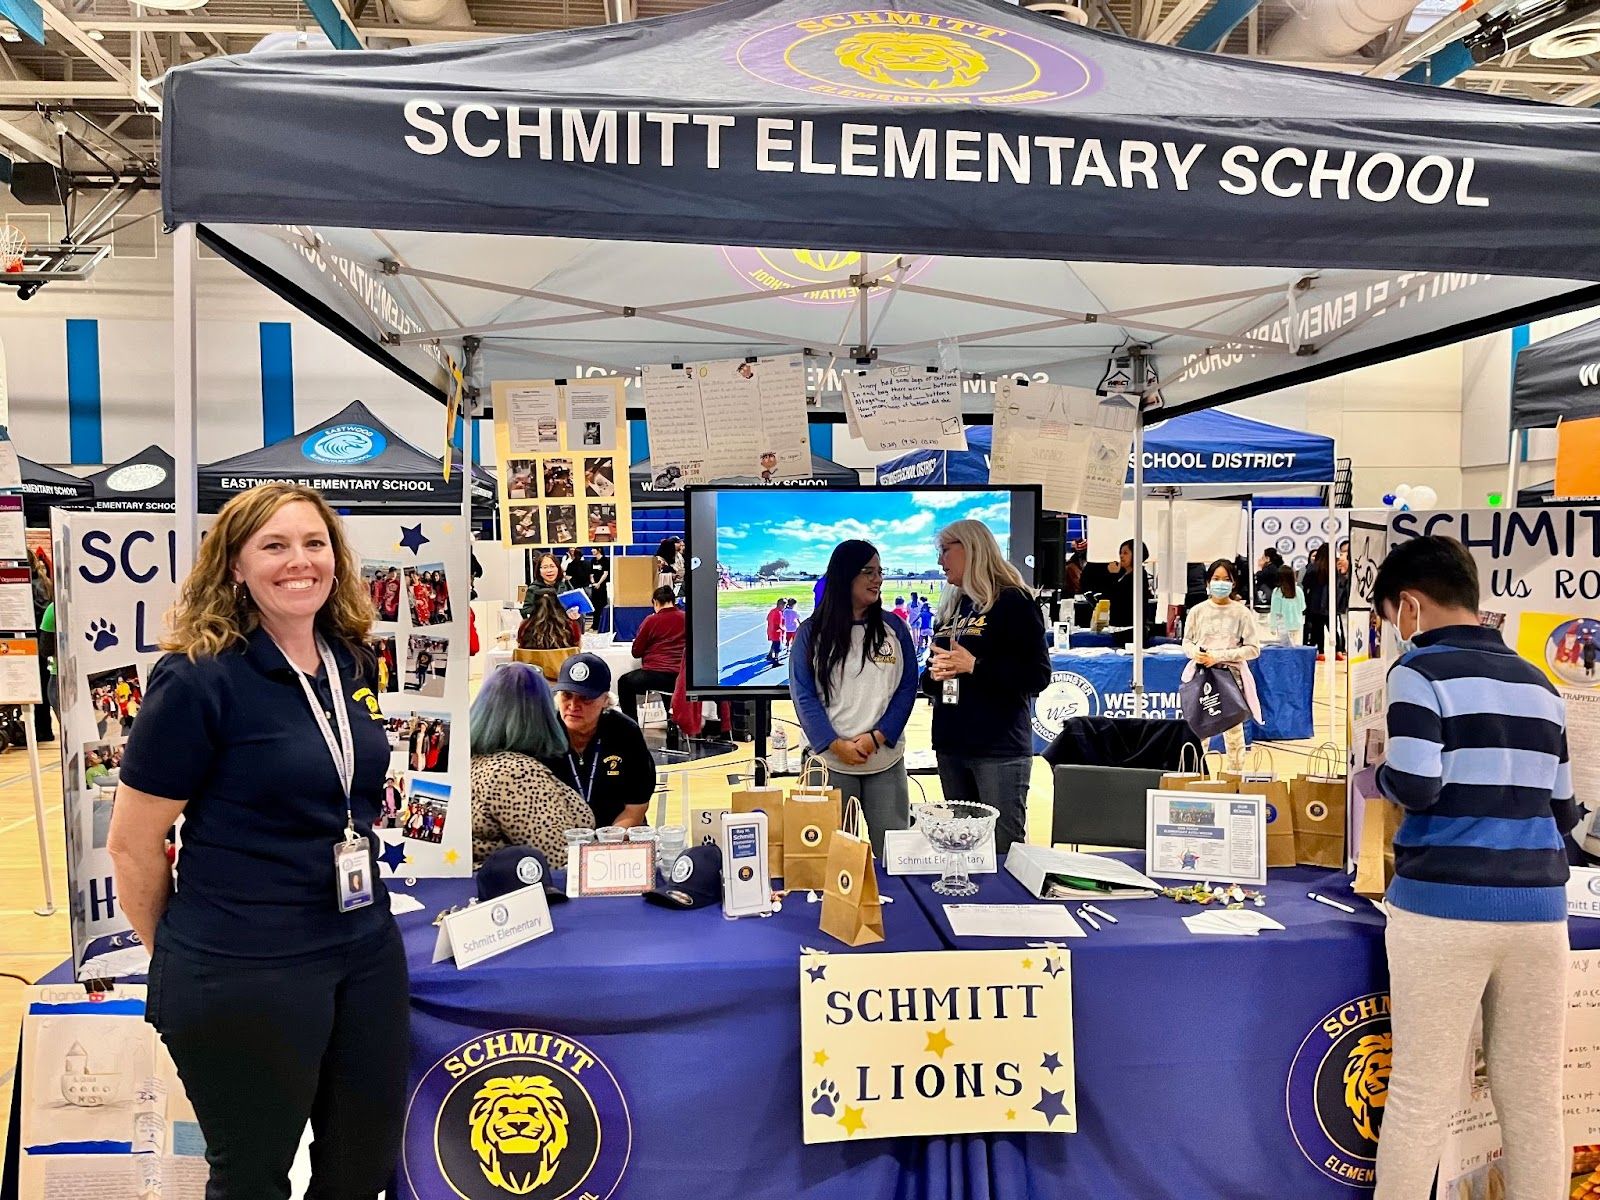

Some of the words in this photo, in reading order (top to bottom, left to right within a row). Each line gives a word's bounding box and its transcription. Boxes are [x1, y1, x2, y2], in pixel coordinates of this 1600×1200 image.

[796, 12, 1006, 39] SCHMITT
[404, 100, 734, 168] SCHMITT
[757, 118, 1206, 191] ELEMENTARY
[1219, 147, 1490, 207] SCHOOL
[1212, 452, 1297, 469] DISTRICT
[382, 480, 434, 492] SCHOOL
[1491, 569, 1533, 598] Us
[733, 833, 755, 841] Schmitt
[592, 853, 643, 882] Slime
[898, 856, 932, 865] Schmitt
[463, 933, 498, 954] Schmitt
[496, 917, 542, 940] Elementary
[826, 985, 1043, 1025] SCHMITT
[444, 1032, 594, 1078] SCHMITT
[856, 1062, 1023, 1101] LIONS
